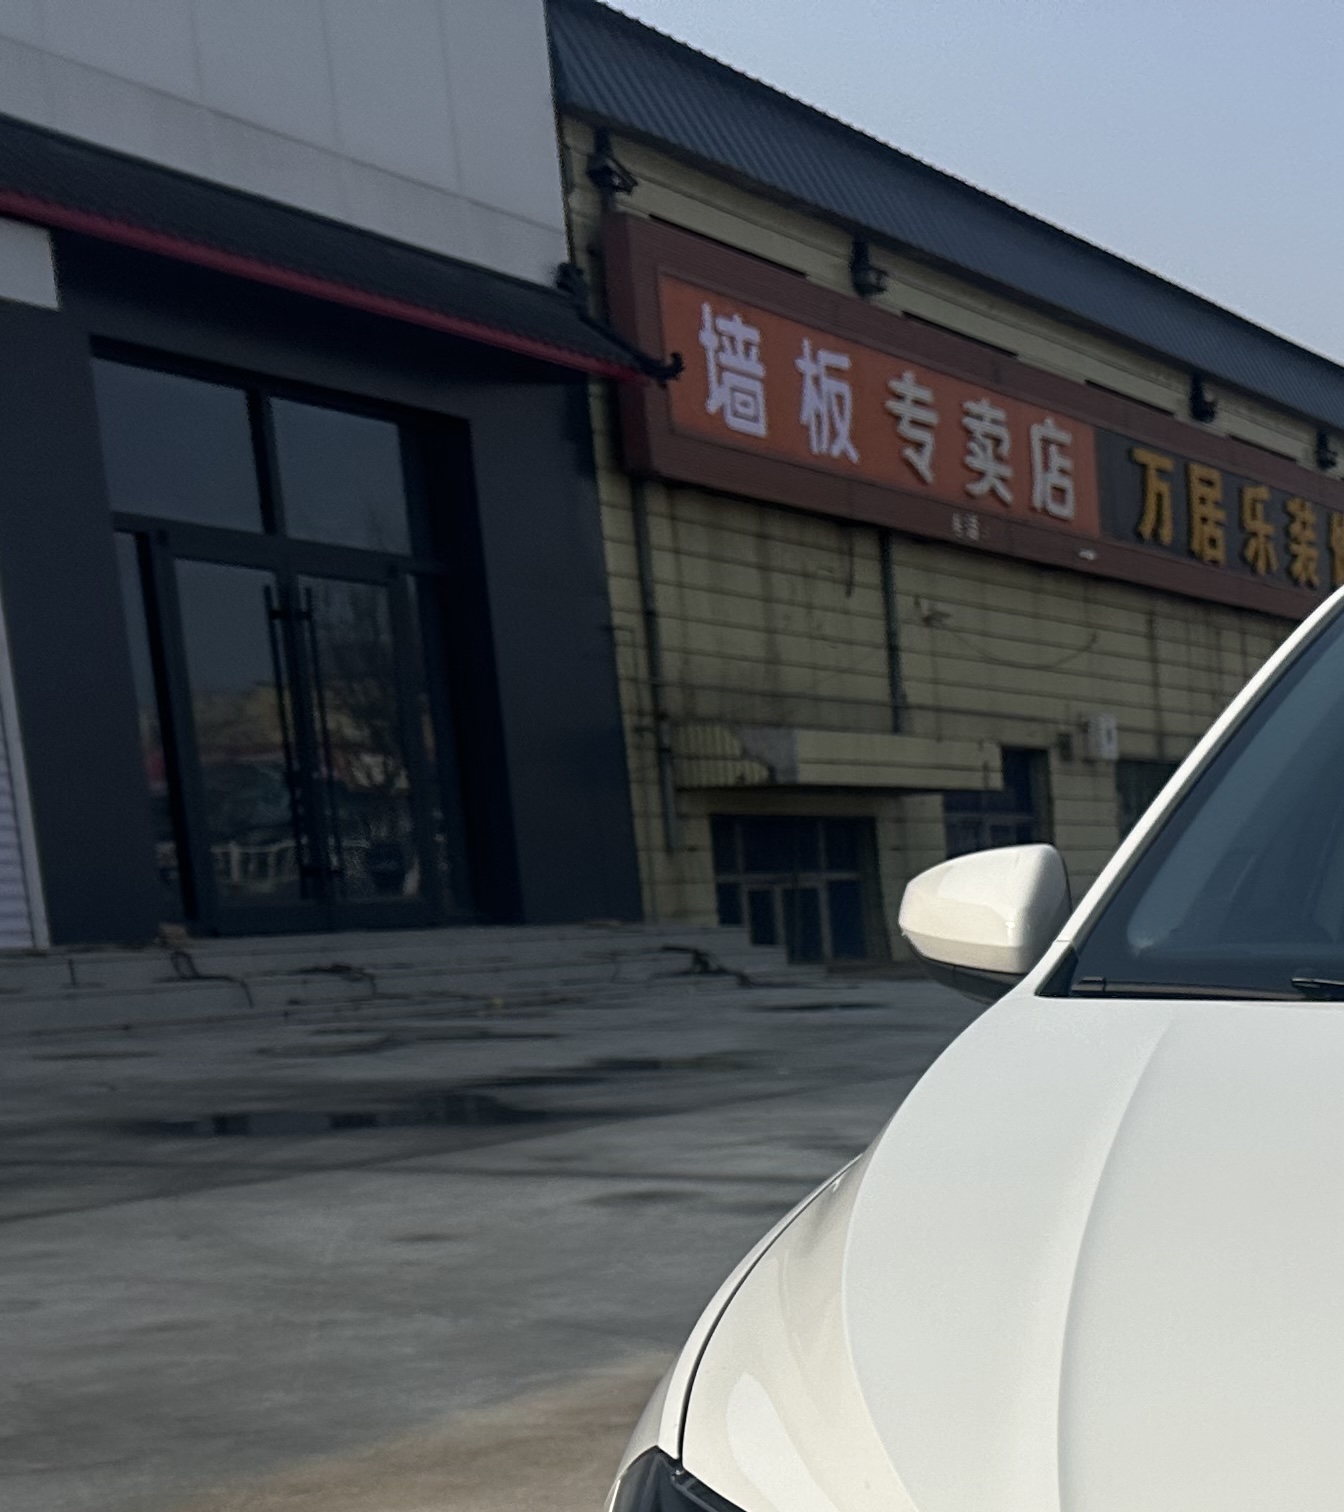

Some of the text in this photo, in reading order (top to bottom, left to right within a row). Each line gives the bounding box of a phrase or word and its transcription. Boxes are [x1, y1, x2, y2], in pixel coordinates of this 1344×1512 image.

[699, 302, 1076, 520] 墙板专卖店
